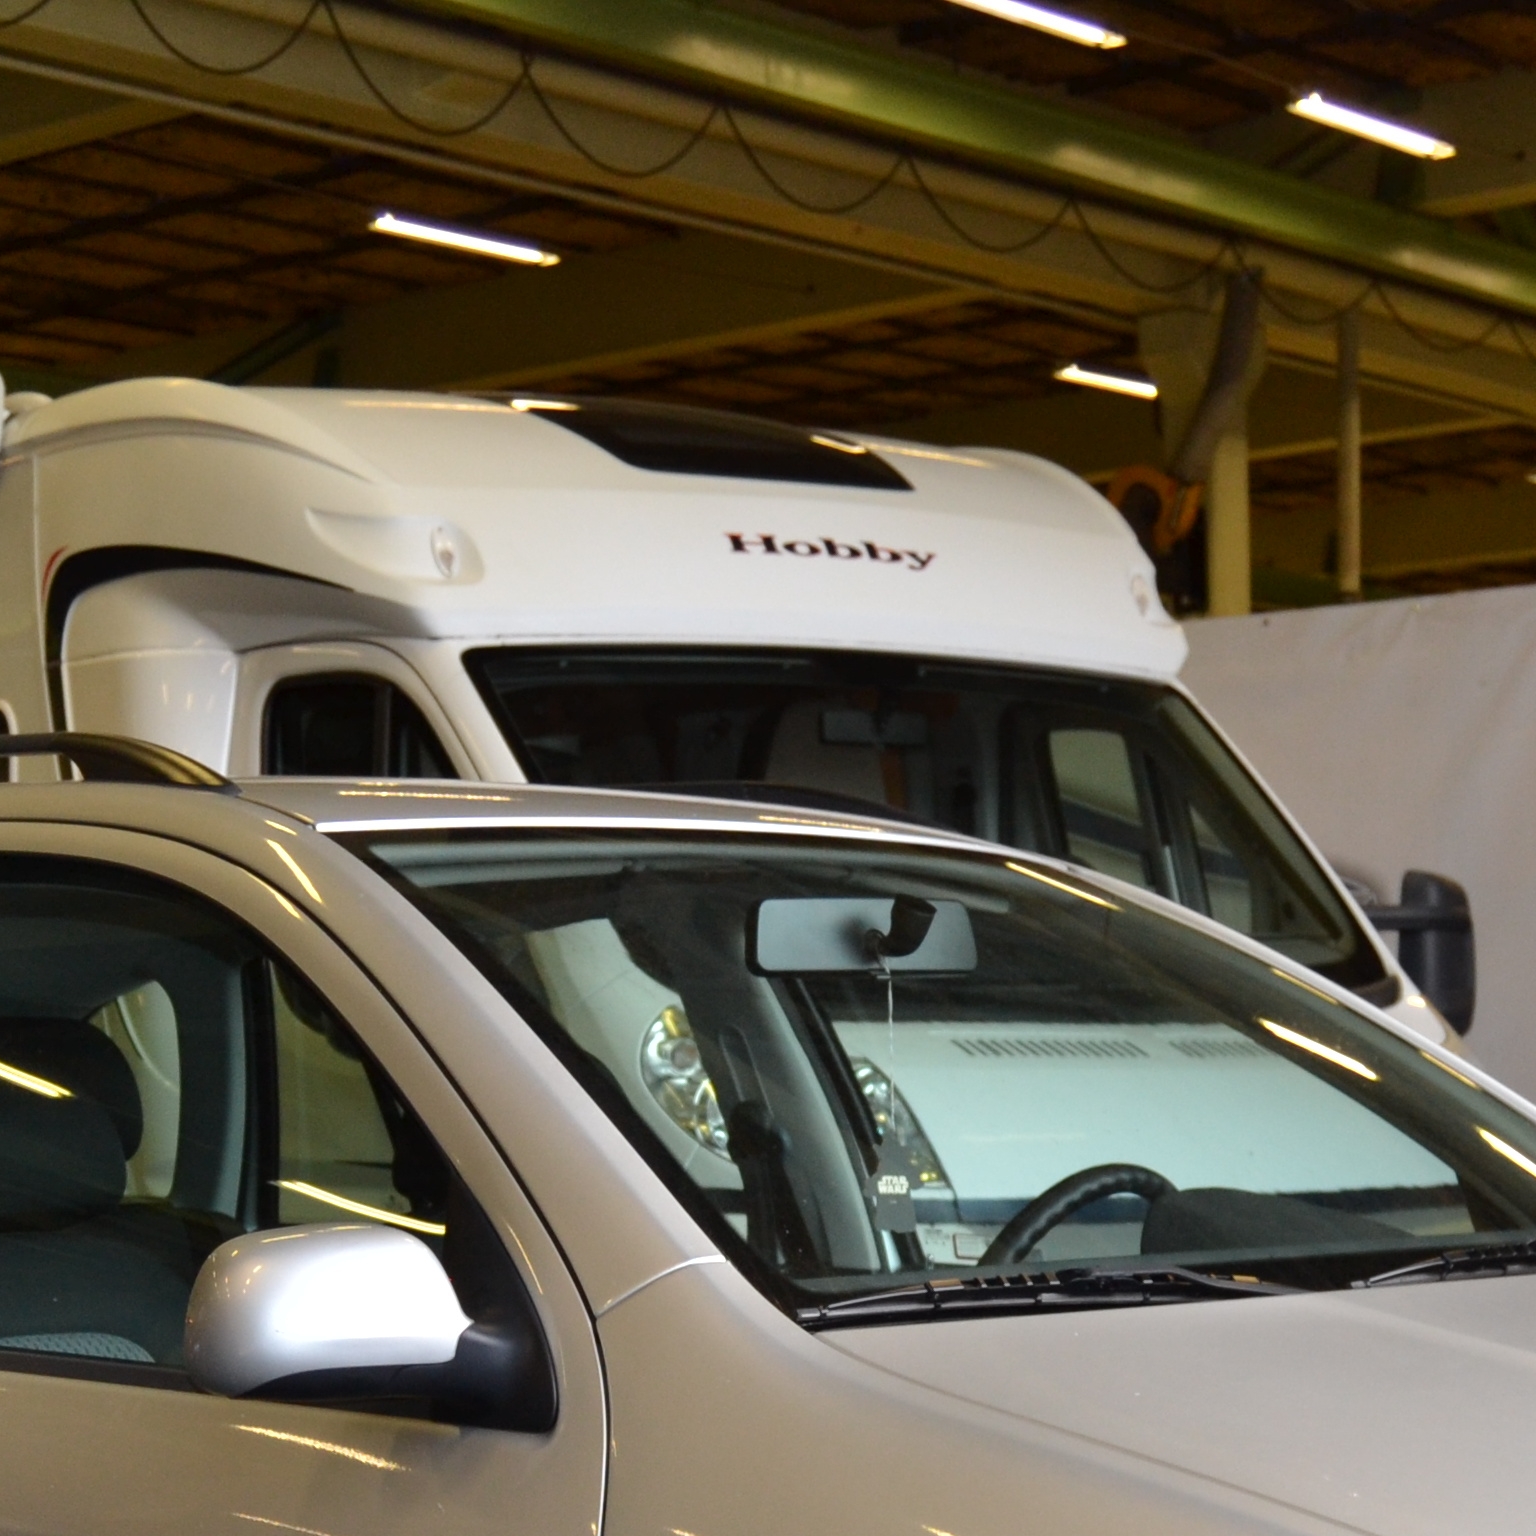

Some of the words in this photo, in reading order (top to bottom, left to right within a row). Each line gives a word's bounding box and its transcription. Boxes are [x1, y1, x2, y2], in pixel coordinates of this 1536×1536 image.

[724, 531, 936, 571] Hobby
[881, 1175, 908, 1185] STAR
[877, 1183, 908, 1195] WARS
